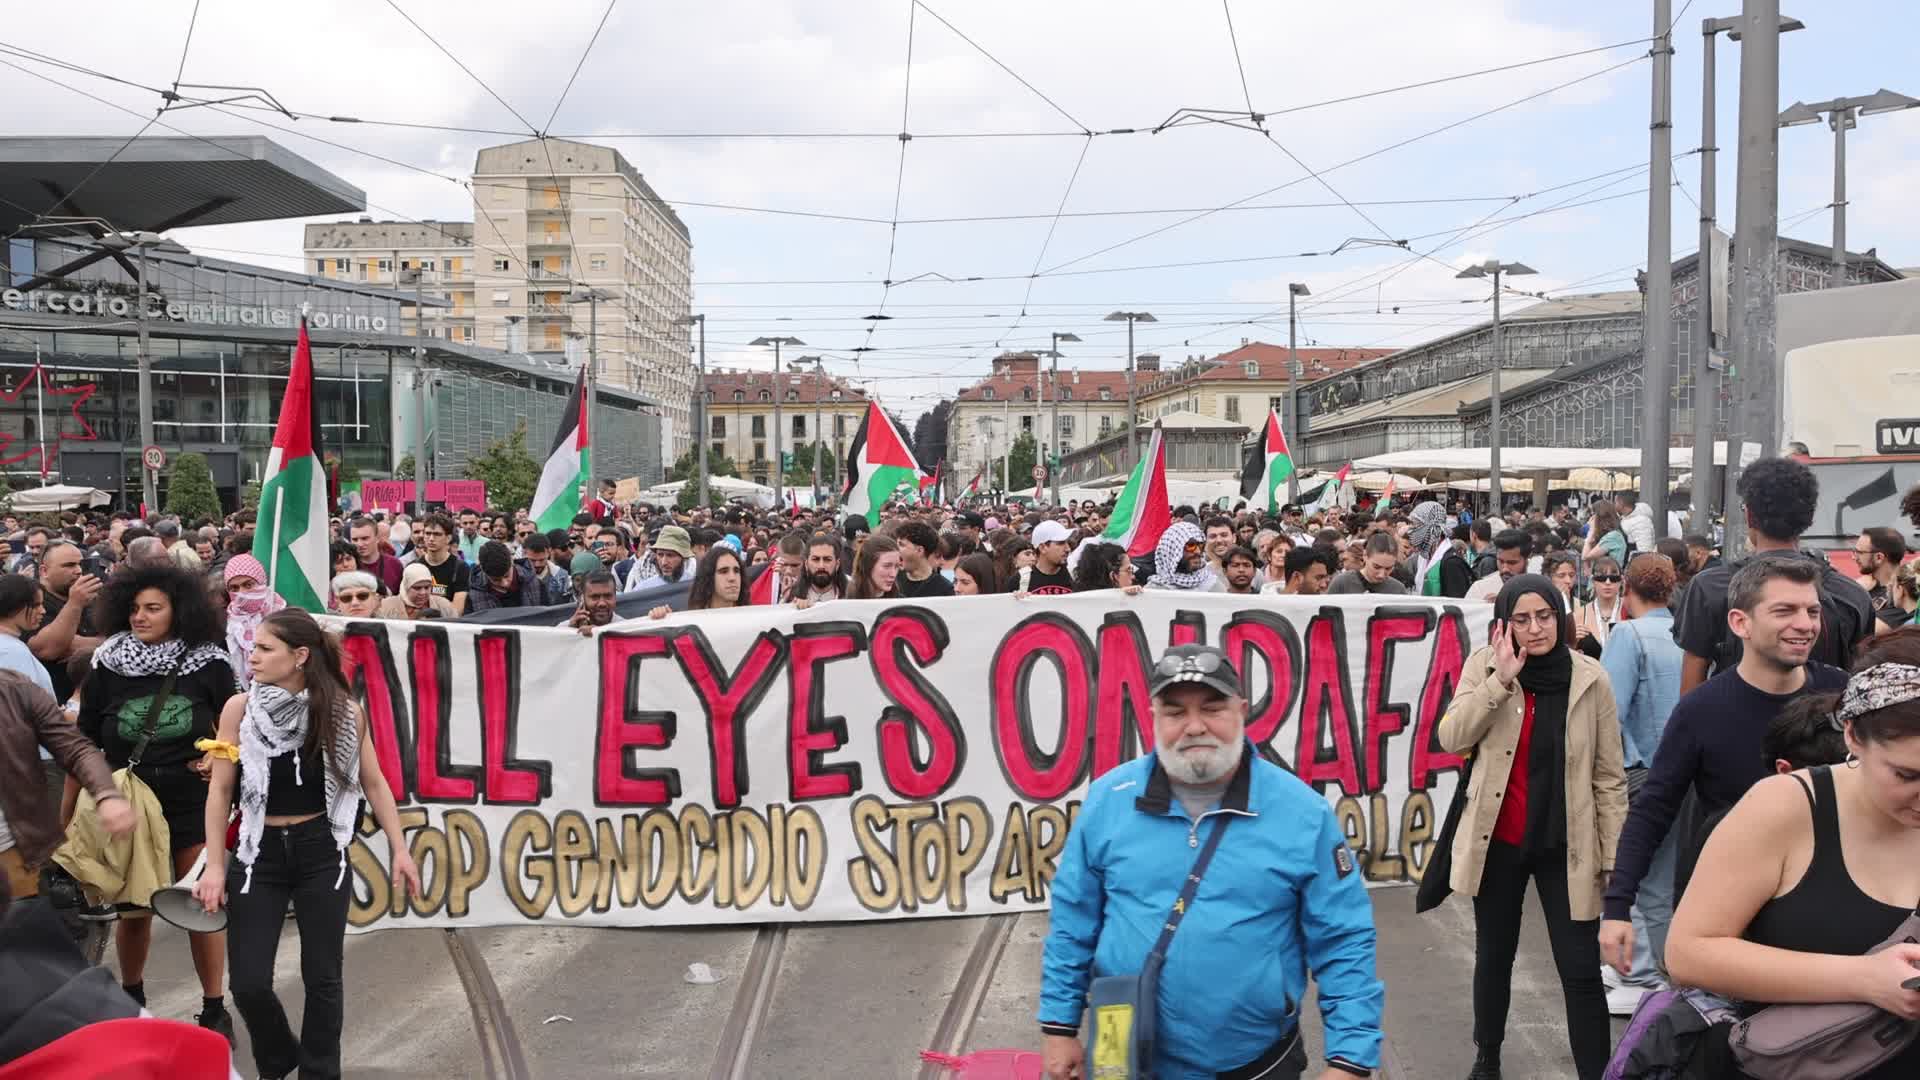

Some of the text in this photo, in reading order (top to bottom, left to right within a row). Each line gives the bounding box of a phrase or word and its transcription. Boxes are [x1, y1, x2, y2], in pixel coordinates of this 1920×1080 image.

[2, 288, 129, 316] ercato
[148, 451, 160, 464] 30
[341, 622, 552, 806] ALL
[593, 605, 968, 808] EYES
[1219, 607, 1499, 796] RAFA
[847, 794, 993, 913] STOP
[989, 800, 1082, 904] AR
